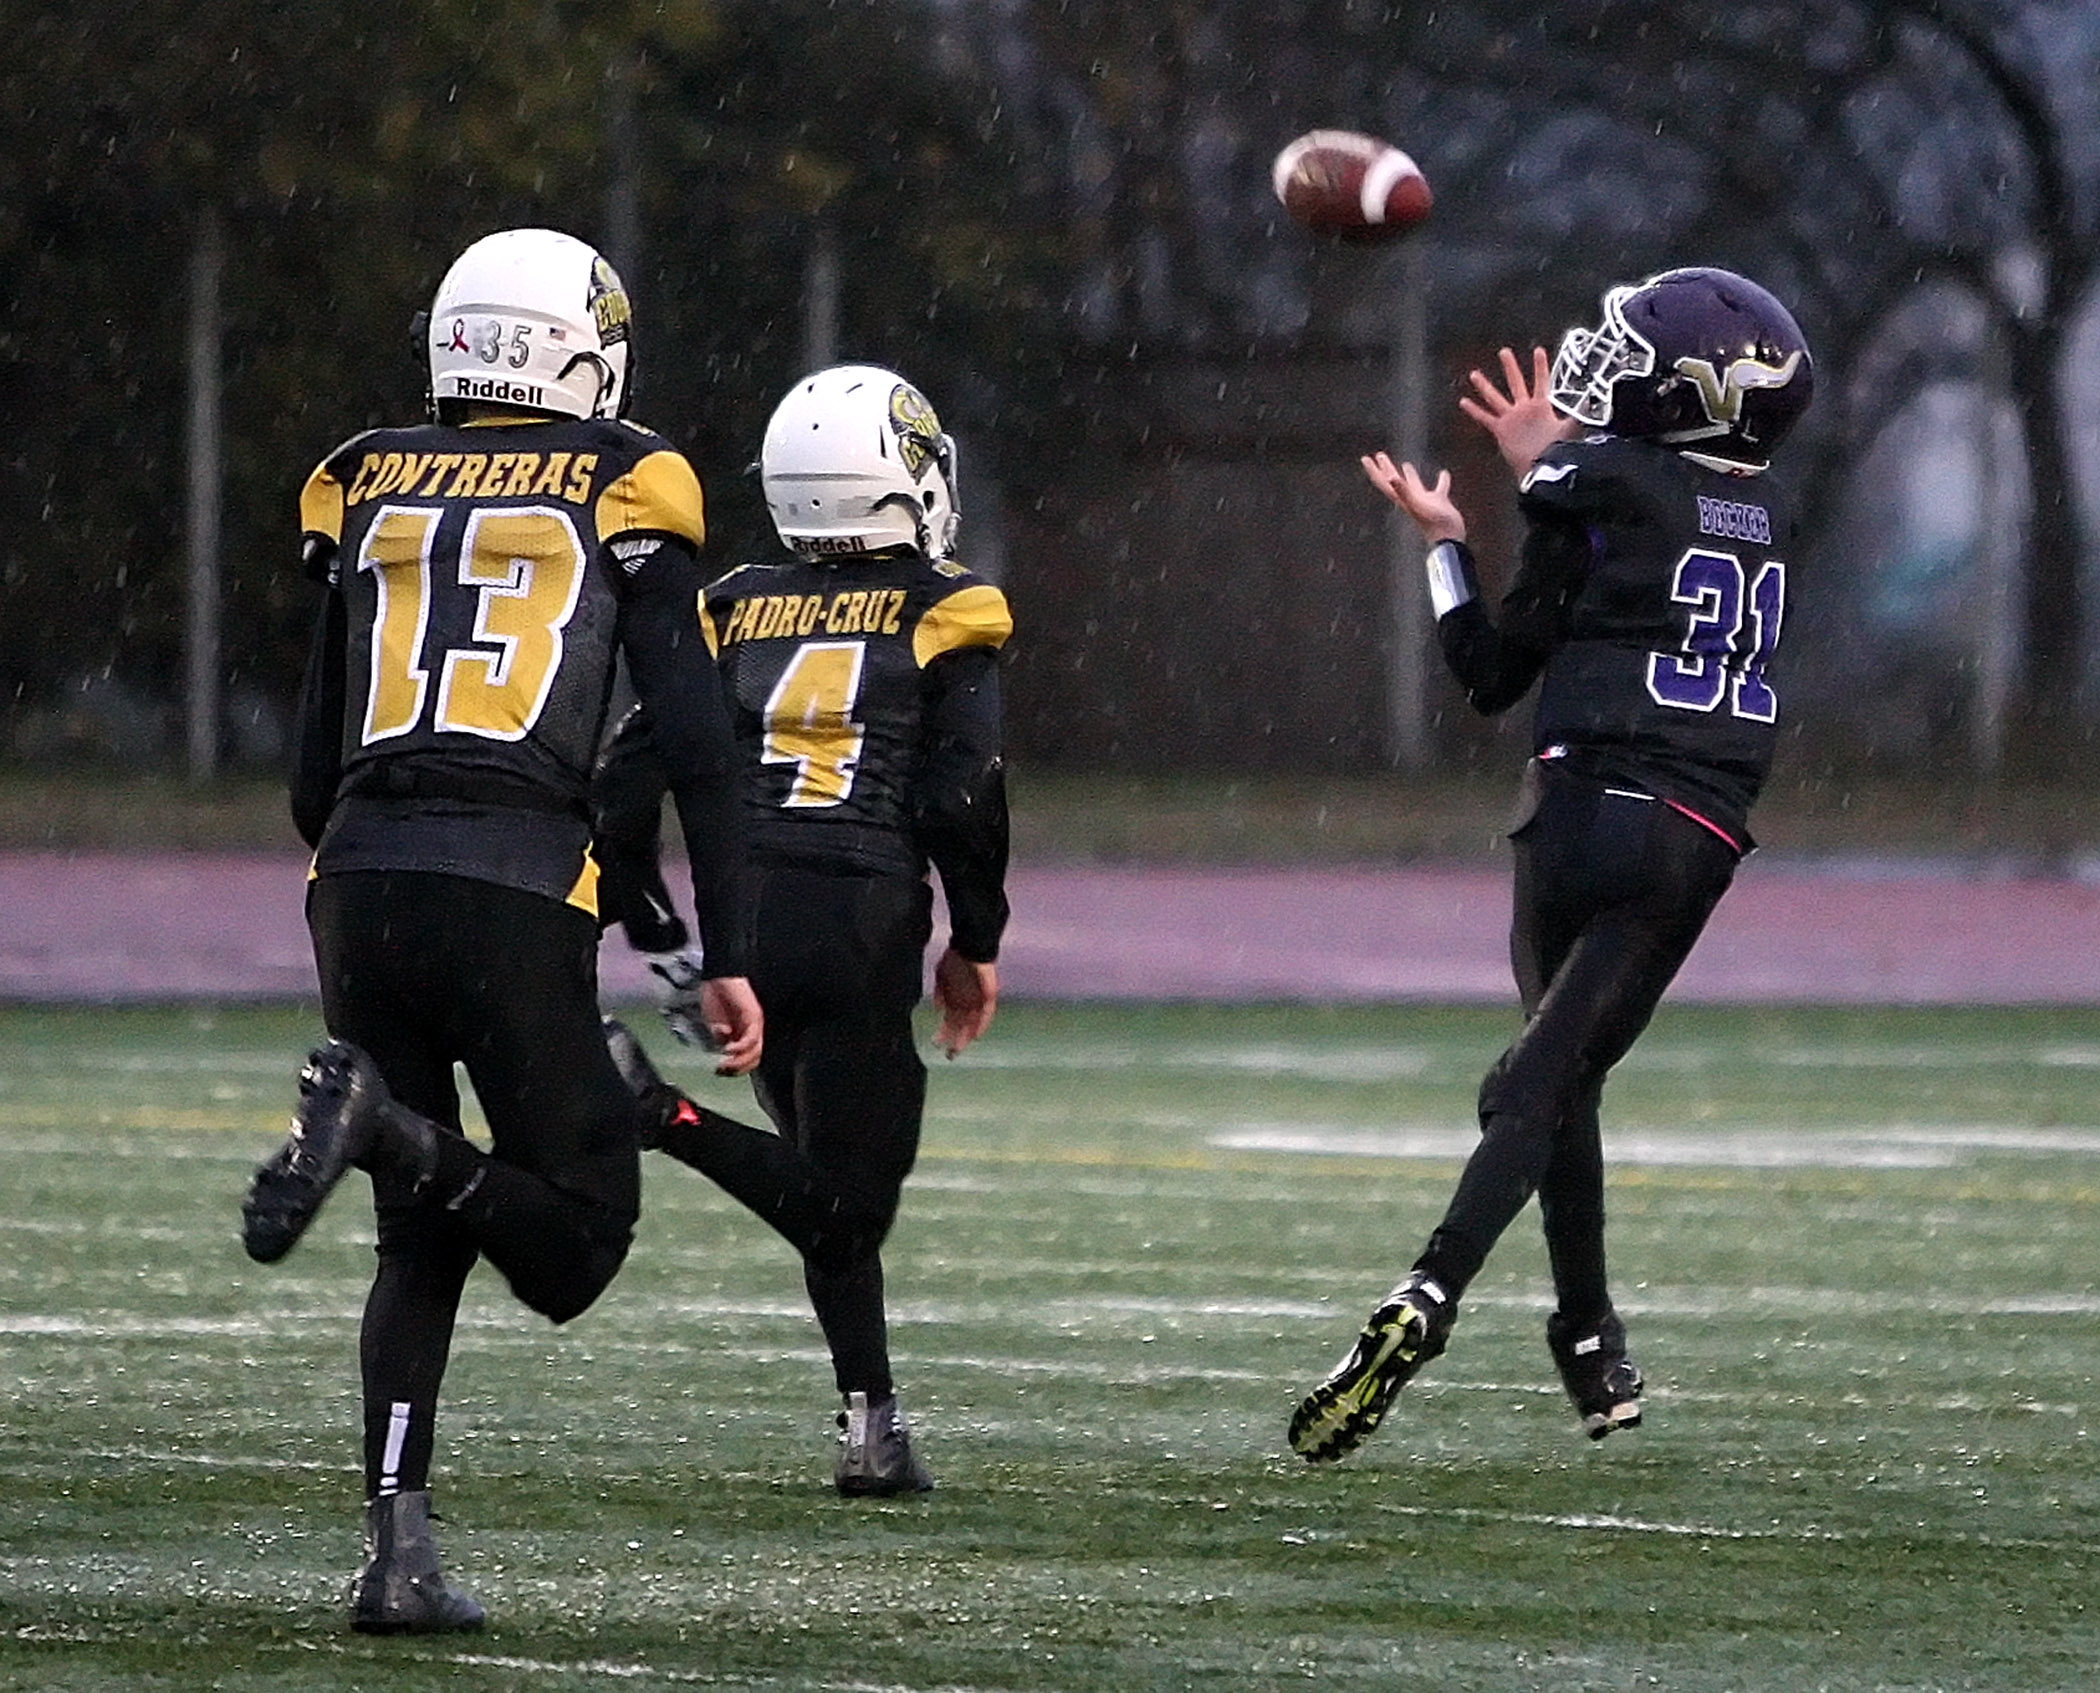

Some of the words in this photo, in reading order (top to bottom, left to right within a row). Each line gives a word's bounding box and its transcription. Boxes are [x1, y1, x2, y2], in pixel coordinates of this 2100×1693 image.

[480, 320, 532, 369] 35
[457, 377, 543, 405] Riddell
[346, 452, 599, 506] CONTRERAS
[357, 505, 586, 747] 13
[722, 589, 908, 647] PADRO-CRUZ
[1646, 547, 1785, 724] 31
[760, 641, 867, 808] 4
